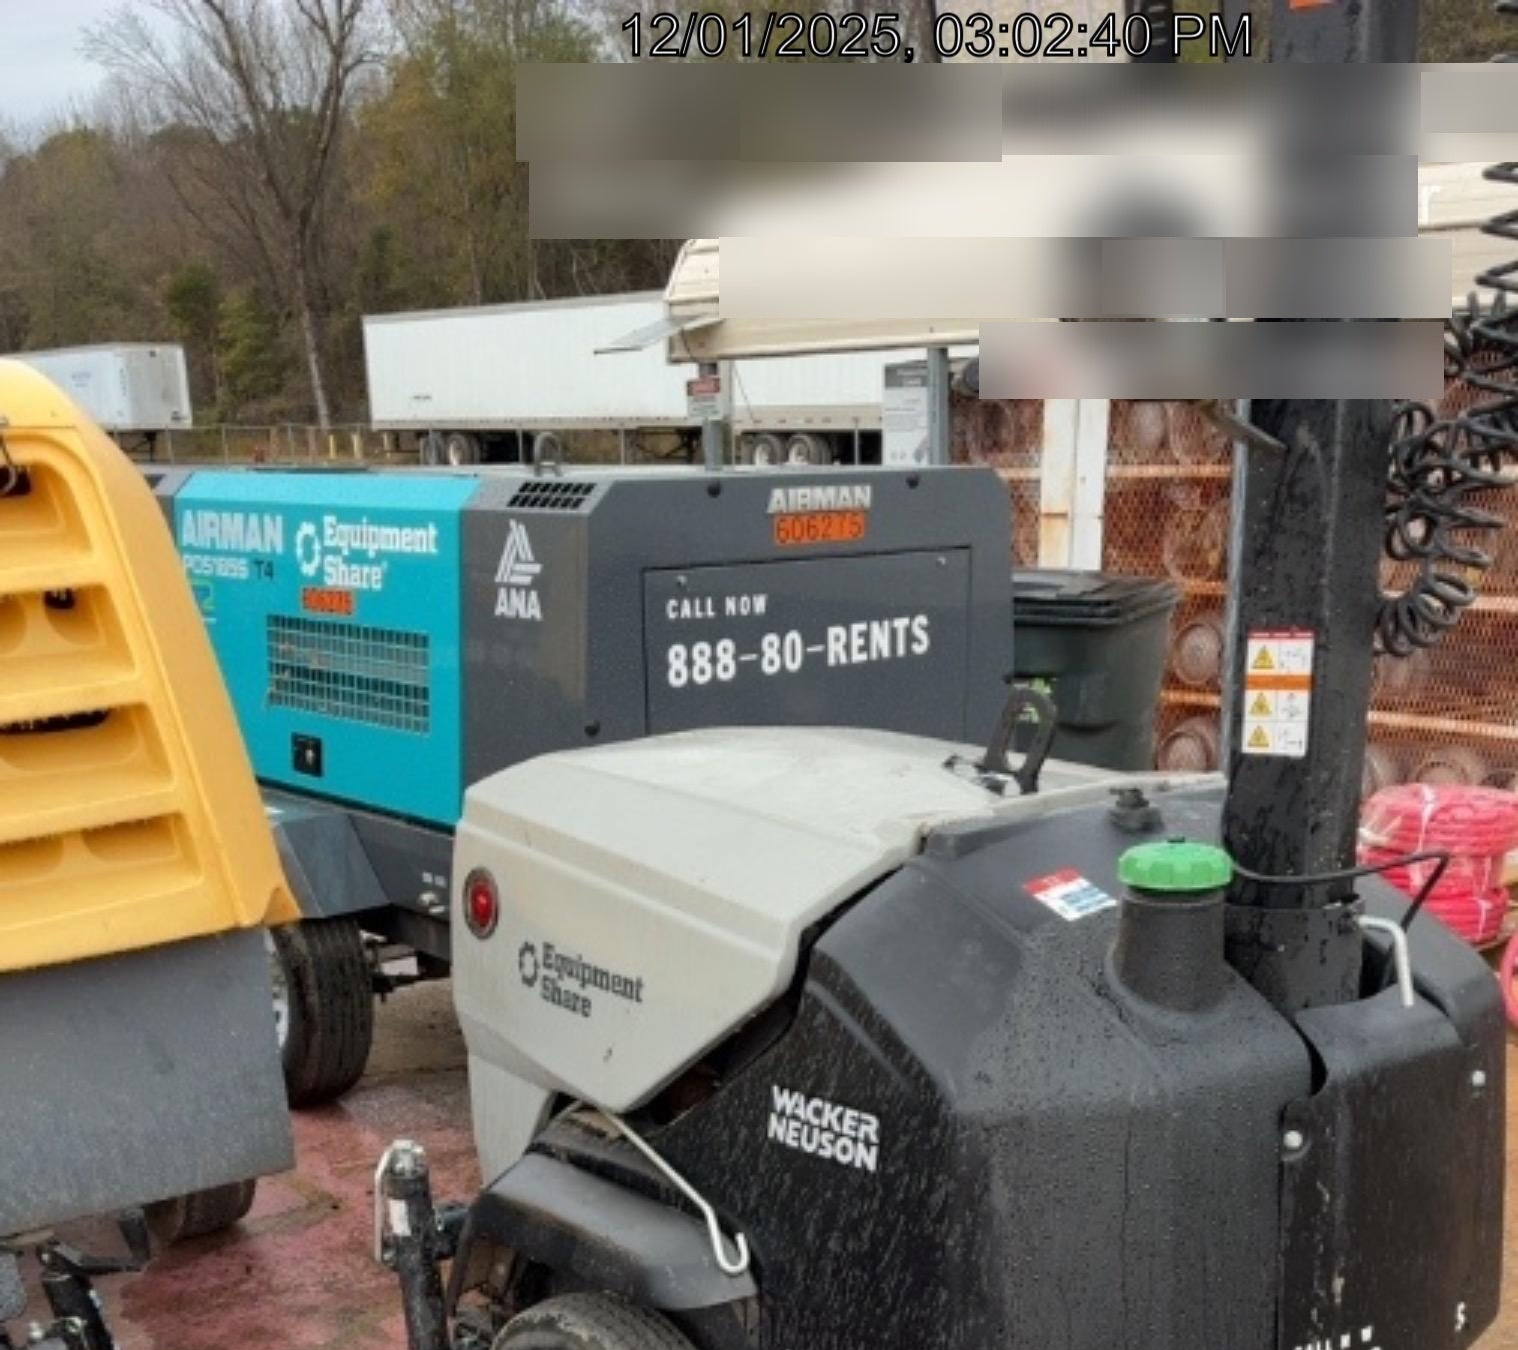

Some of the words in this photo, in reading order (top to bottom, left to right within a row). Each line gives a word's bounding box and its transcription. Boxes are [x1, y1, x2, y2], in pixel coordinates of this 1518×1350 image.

[767, 485, 871, 513] AIRMAN
[182, 510, 283, 555] AIRMAN
[323, 515, 438, 558] Equipment
[323, 555, 382, 591] Share
[494, 586, 543, 621] ANA
[665, 597, 716, 620] CALL
[725, 593, 769, 617] NOW
[666, 614, 931, 688] 888-80-RENTS
[541, 941, 645, 1004] Equipment
[540, 974, 592, 1019] Share
[771, 1083, 880, 1144] WACKER
[767, 1112, 879, 1173] NEUSON
